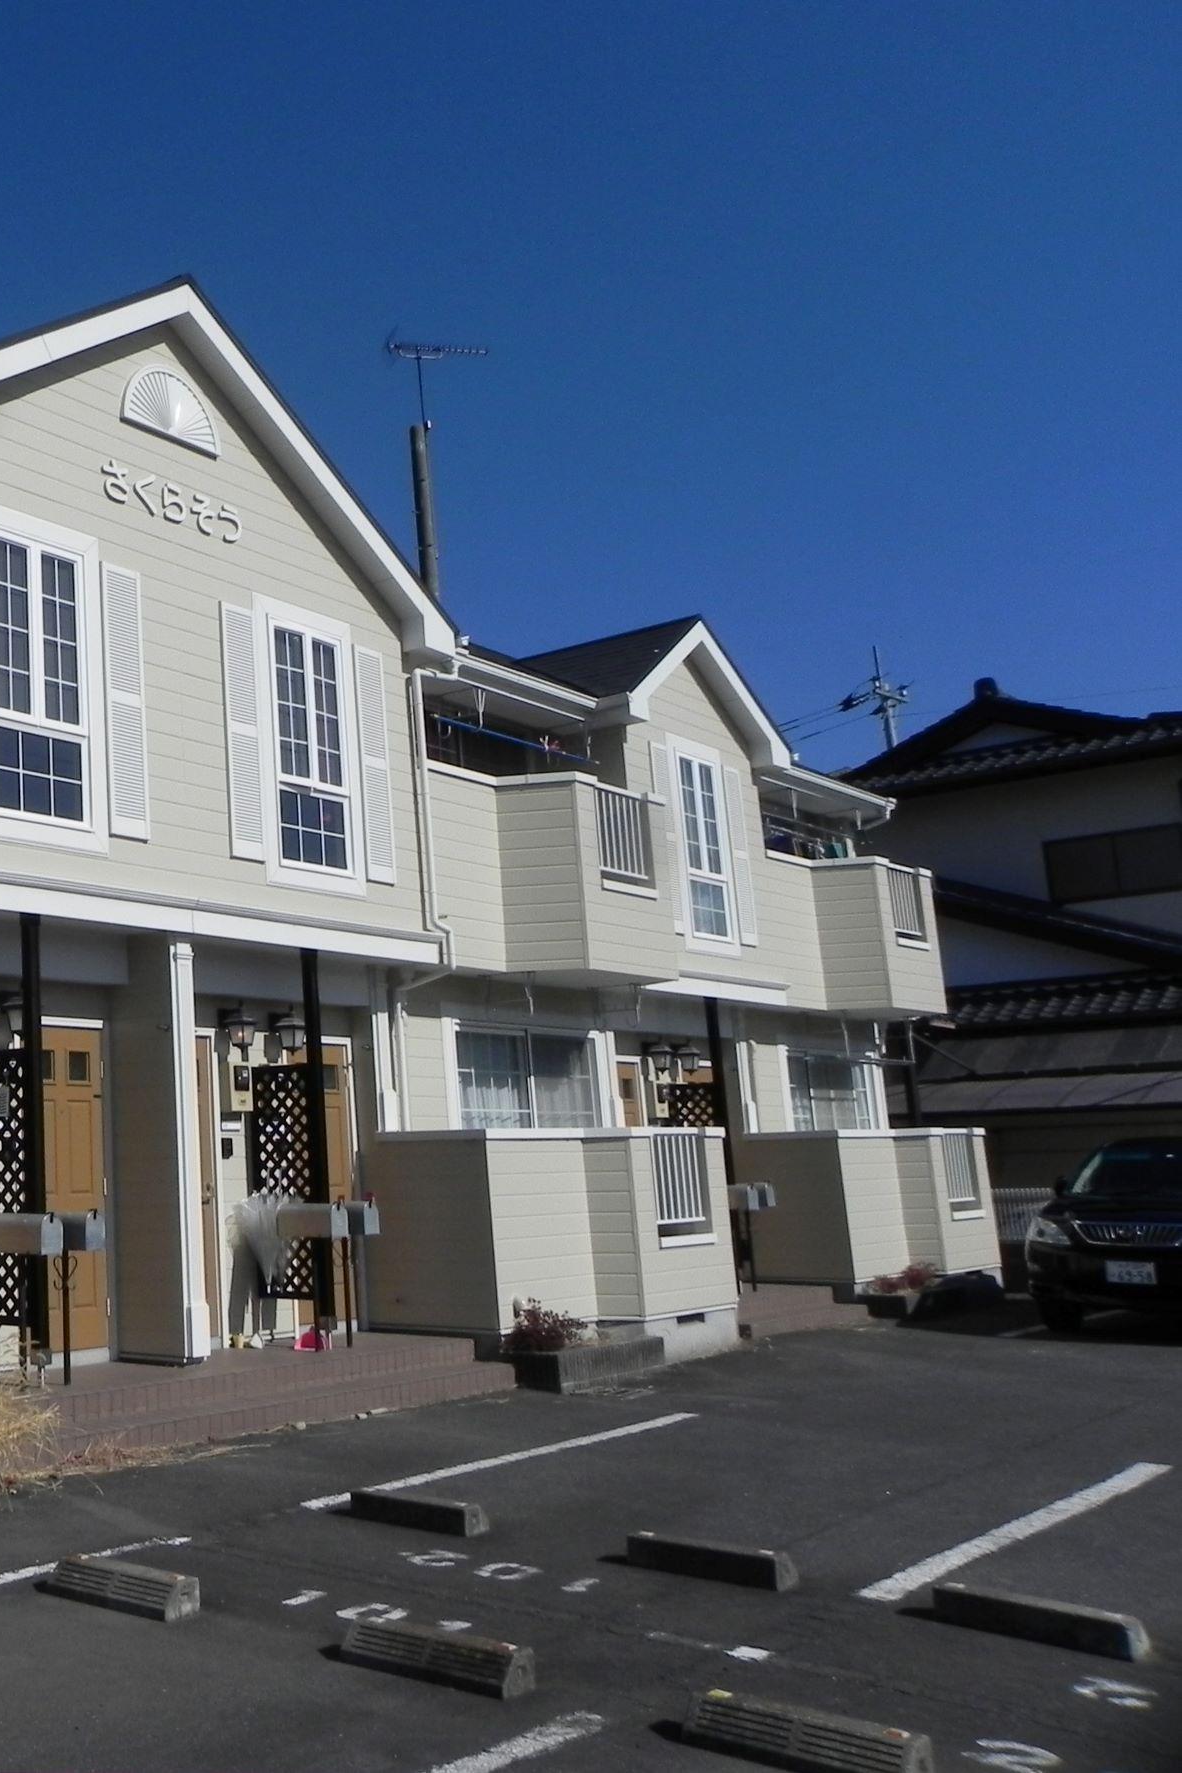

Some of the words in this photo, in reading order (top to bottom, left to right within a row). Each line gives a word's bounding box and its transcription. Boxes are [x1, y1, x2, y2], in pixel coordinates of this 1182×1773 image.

[101, 458, 243, 544] さくらそう
